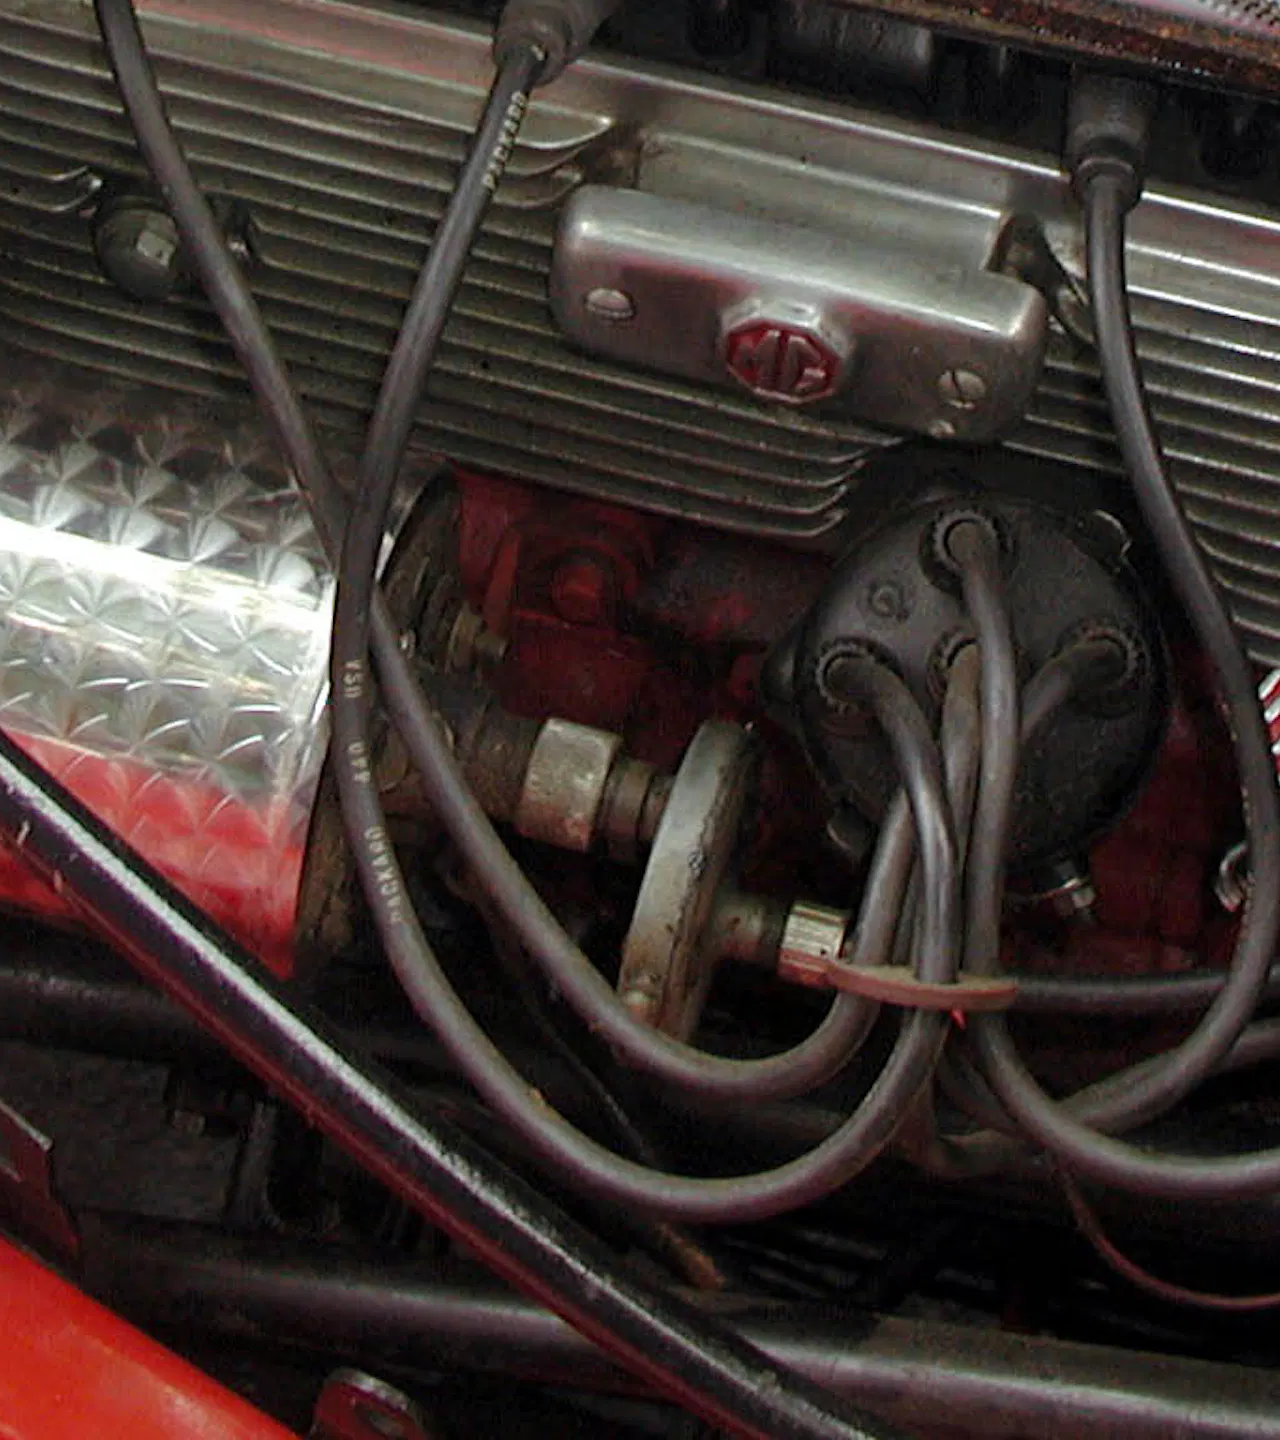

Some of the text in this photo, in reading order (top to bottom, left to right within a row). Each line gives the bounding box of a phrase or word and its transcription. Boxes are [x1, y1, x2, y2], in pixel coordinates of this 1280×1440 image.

[481, 90, 526, 190] PACKARD
[731, 327, 828, 398] MG
[342, 659, 403, 924] PACKARD 440 USA
